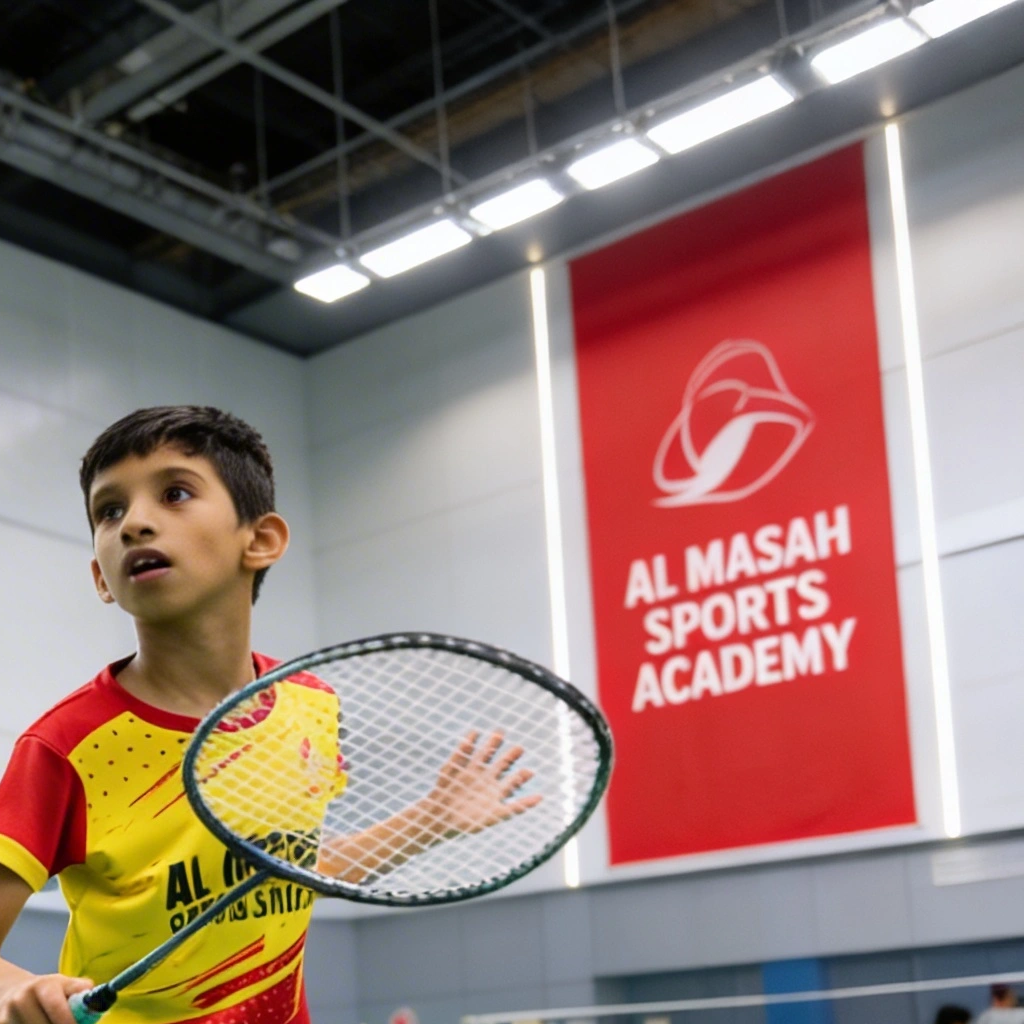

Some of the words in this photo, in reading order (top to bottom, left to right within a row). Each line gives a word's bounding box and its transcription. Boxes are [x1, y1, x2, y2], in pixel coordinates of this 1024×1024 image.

[625, 555, 679, 609] AL
[685, 506, 852, 593] MASAH
[643, 569, 830, 655] SPORTS
[632, 618, 857, 712] ACADEMY
[166, 856, 211, 911] AL
